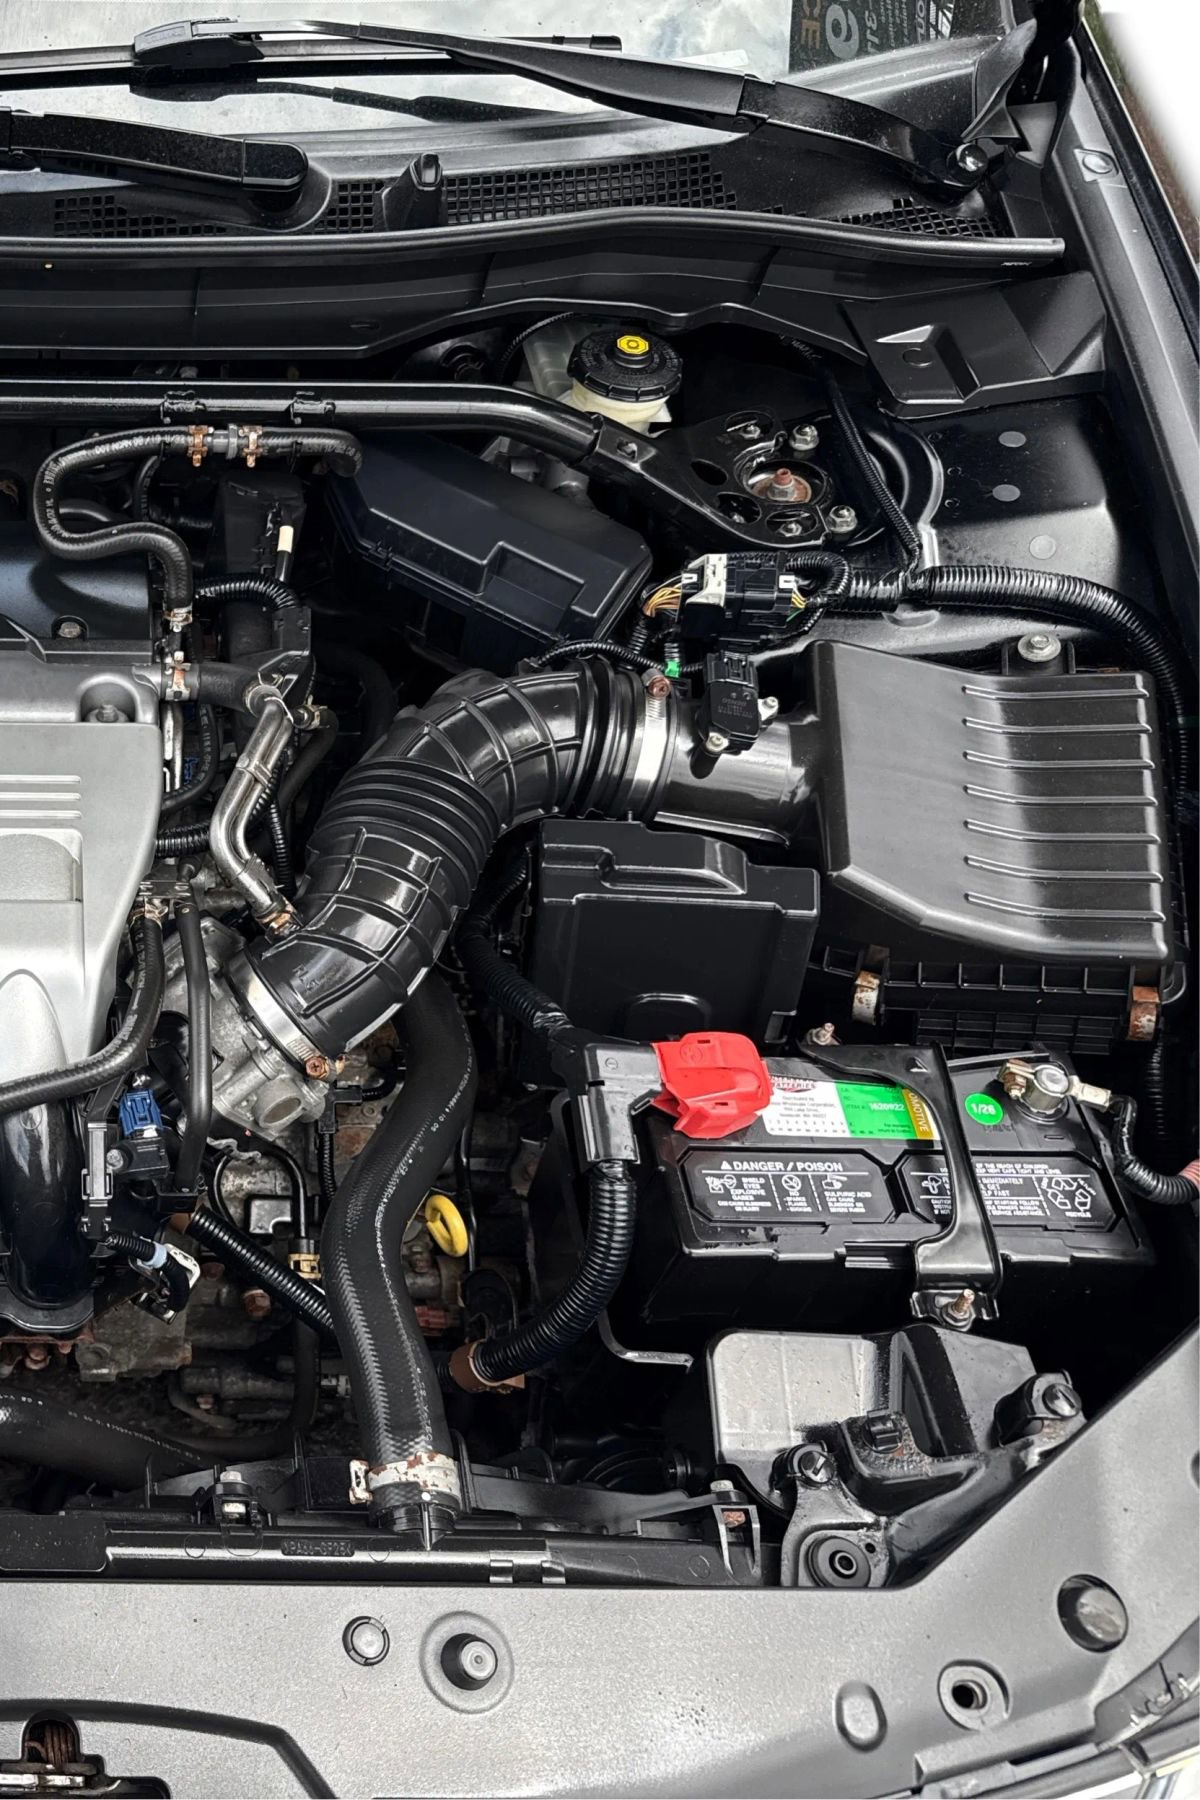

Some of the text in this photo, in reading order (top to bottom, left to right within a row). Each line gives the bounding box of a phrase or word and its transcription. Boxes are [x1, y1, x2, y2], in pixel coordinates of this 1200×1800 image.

[733, 1161, 843, 1172] DANGER / POISON
